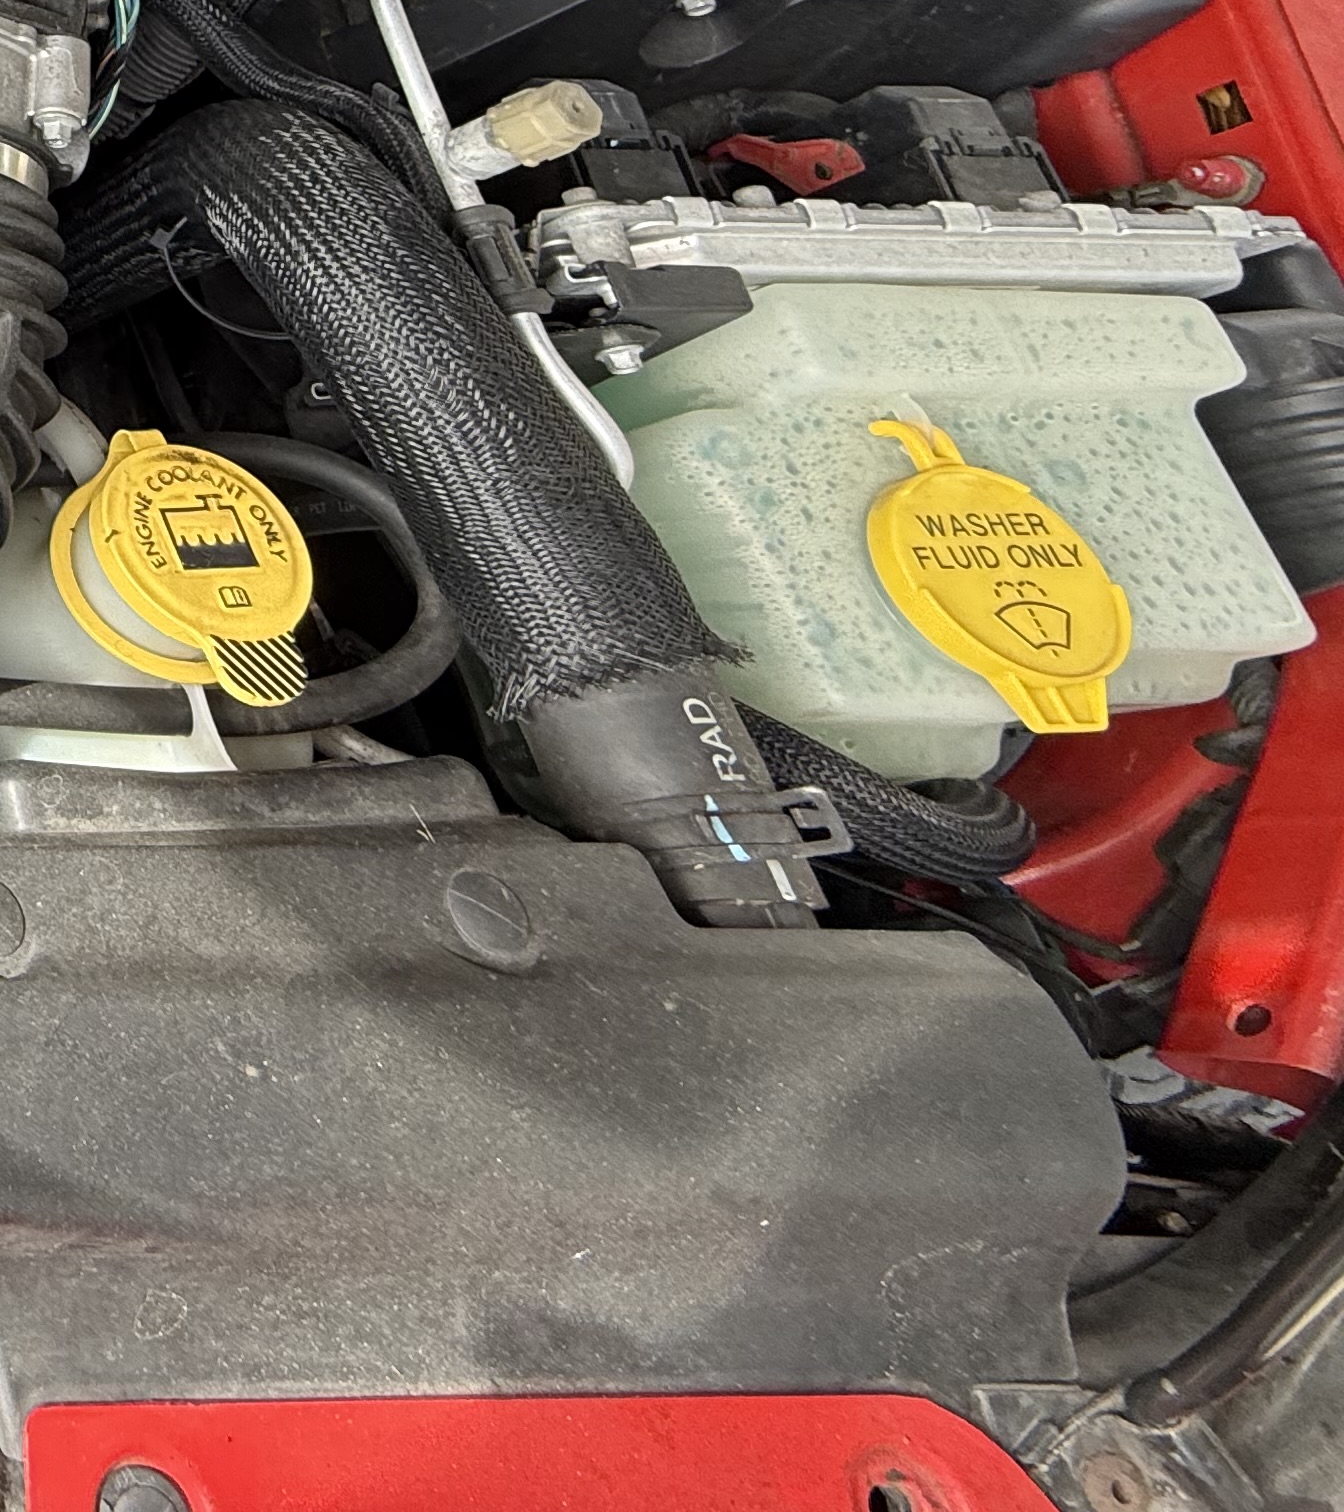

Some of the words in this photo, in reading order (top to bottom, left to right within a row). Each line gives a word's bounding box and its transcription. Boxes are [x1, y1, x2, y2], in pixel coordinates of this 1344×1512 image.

[145, 465, 247, 500] COOLANT
[134, 491, 168, 569] ENGINE
[249, 505, 288, 563] ONLY
[914, 513, 1051, 538] WASHER
[912, 545, 1001, 570] FLUID
[1007, 544, 1083, 569] ONLY
[682, 697, 746, 781] RAD
